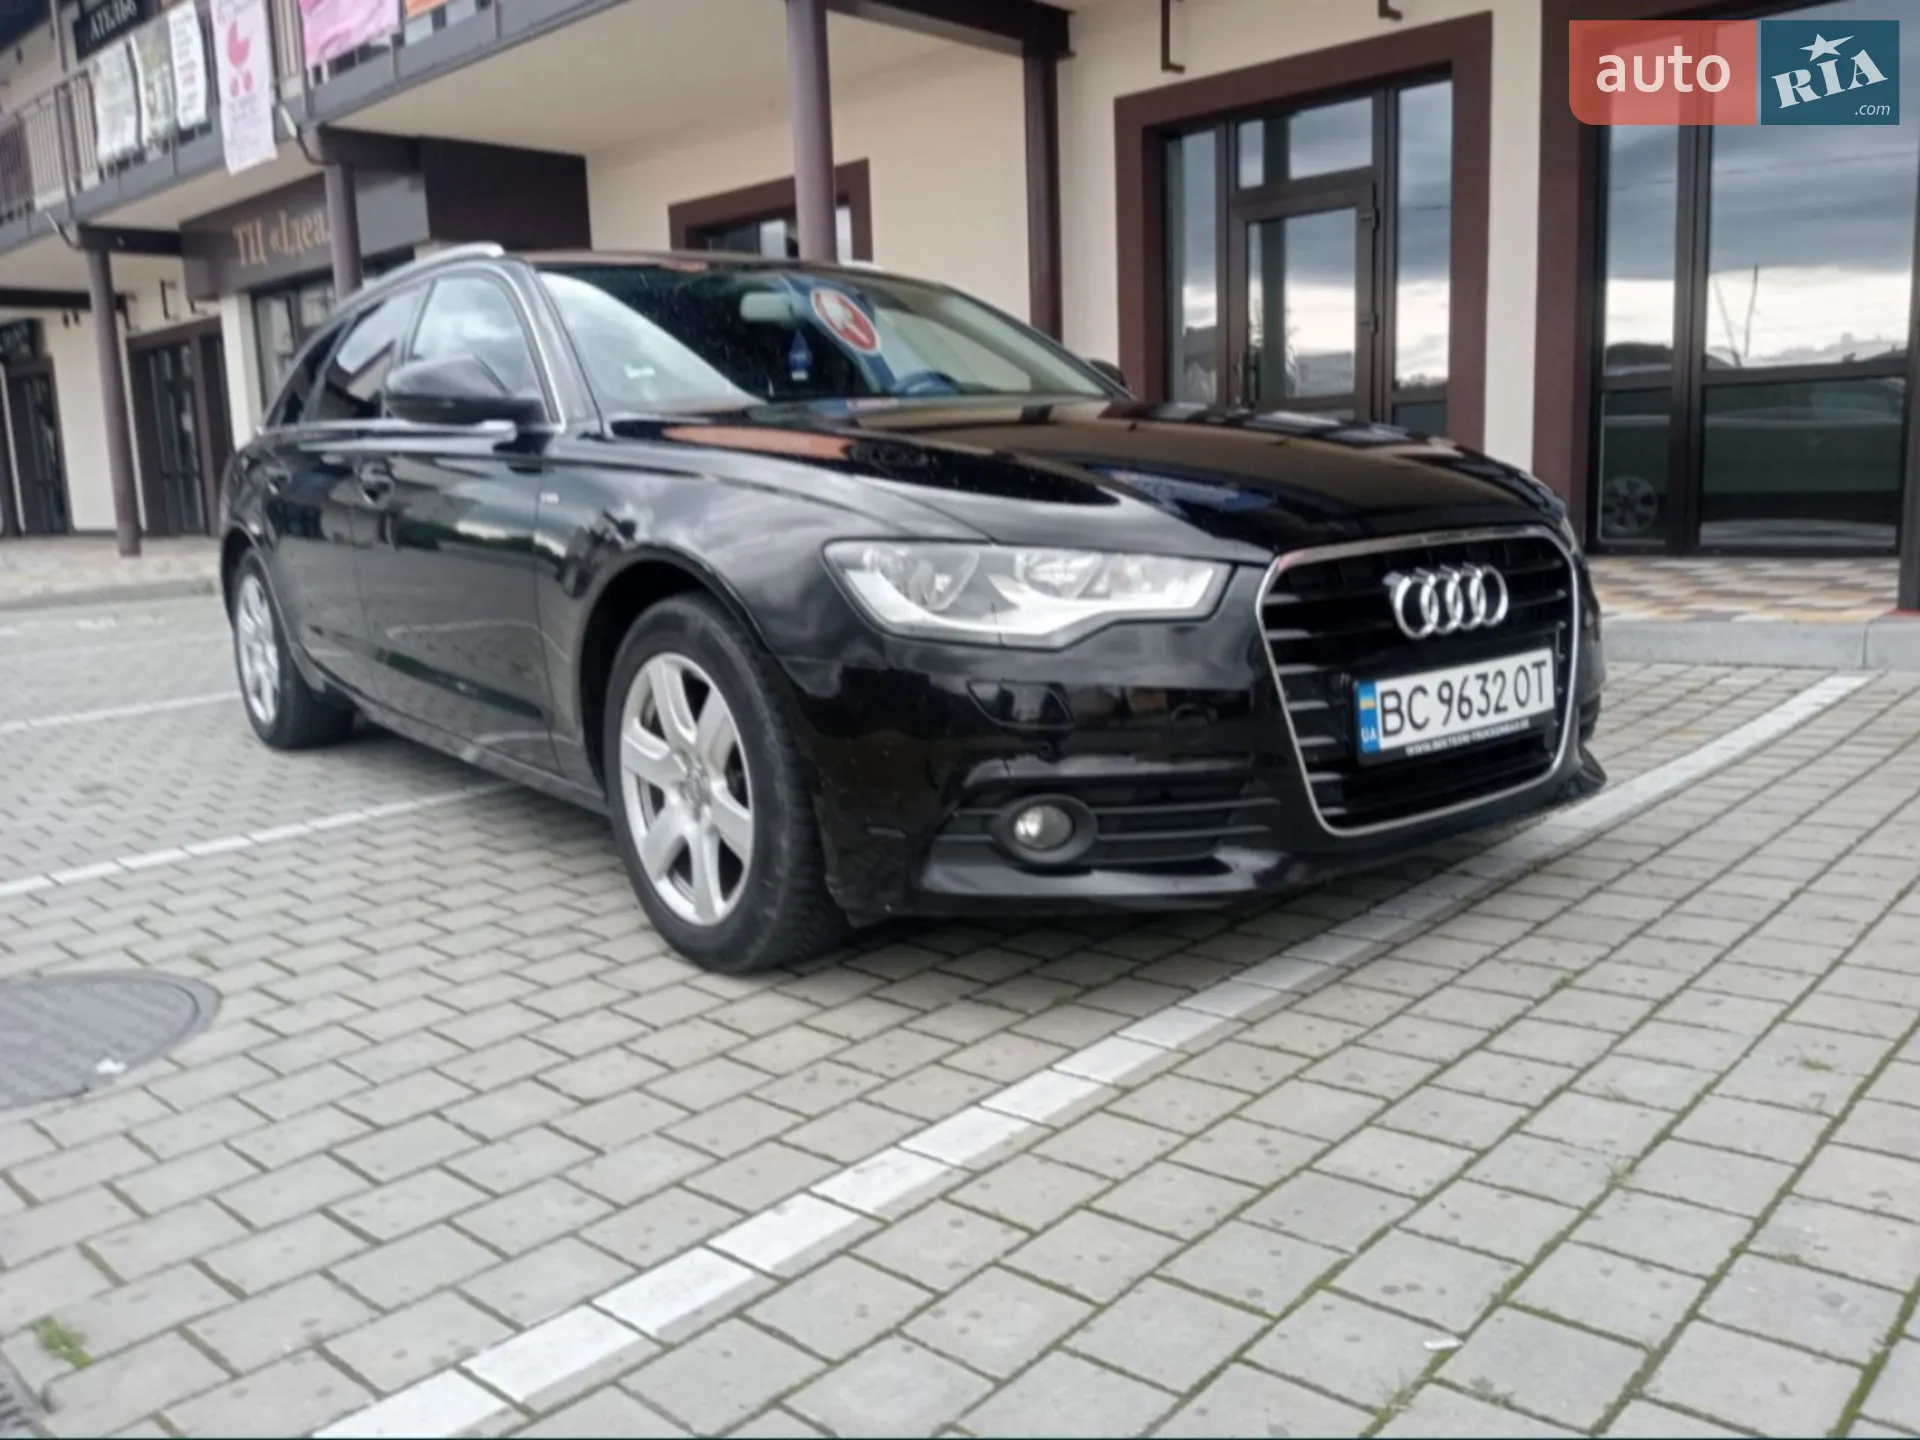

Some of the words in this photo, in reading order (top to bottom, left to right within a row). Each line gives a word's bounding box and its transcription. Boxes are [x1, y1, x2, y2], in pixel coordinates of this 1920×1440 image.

[232, 217, 269, 268] ТЦ
[1380, 685, 1431, 738] BC
[1437, 670, 1509, 727] 9632
[1513, 659, 1548, 707] OT
[1361, 726, 1377, 744] UA
